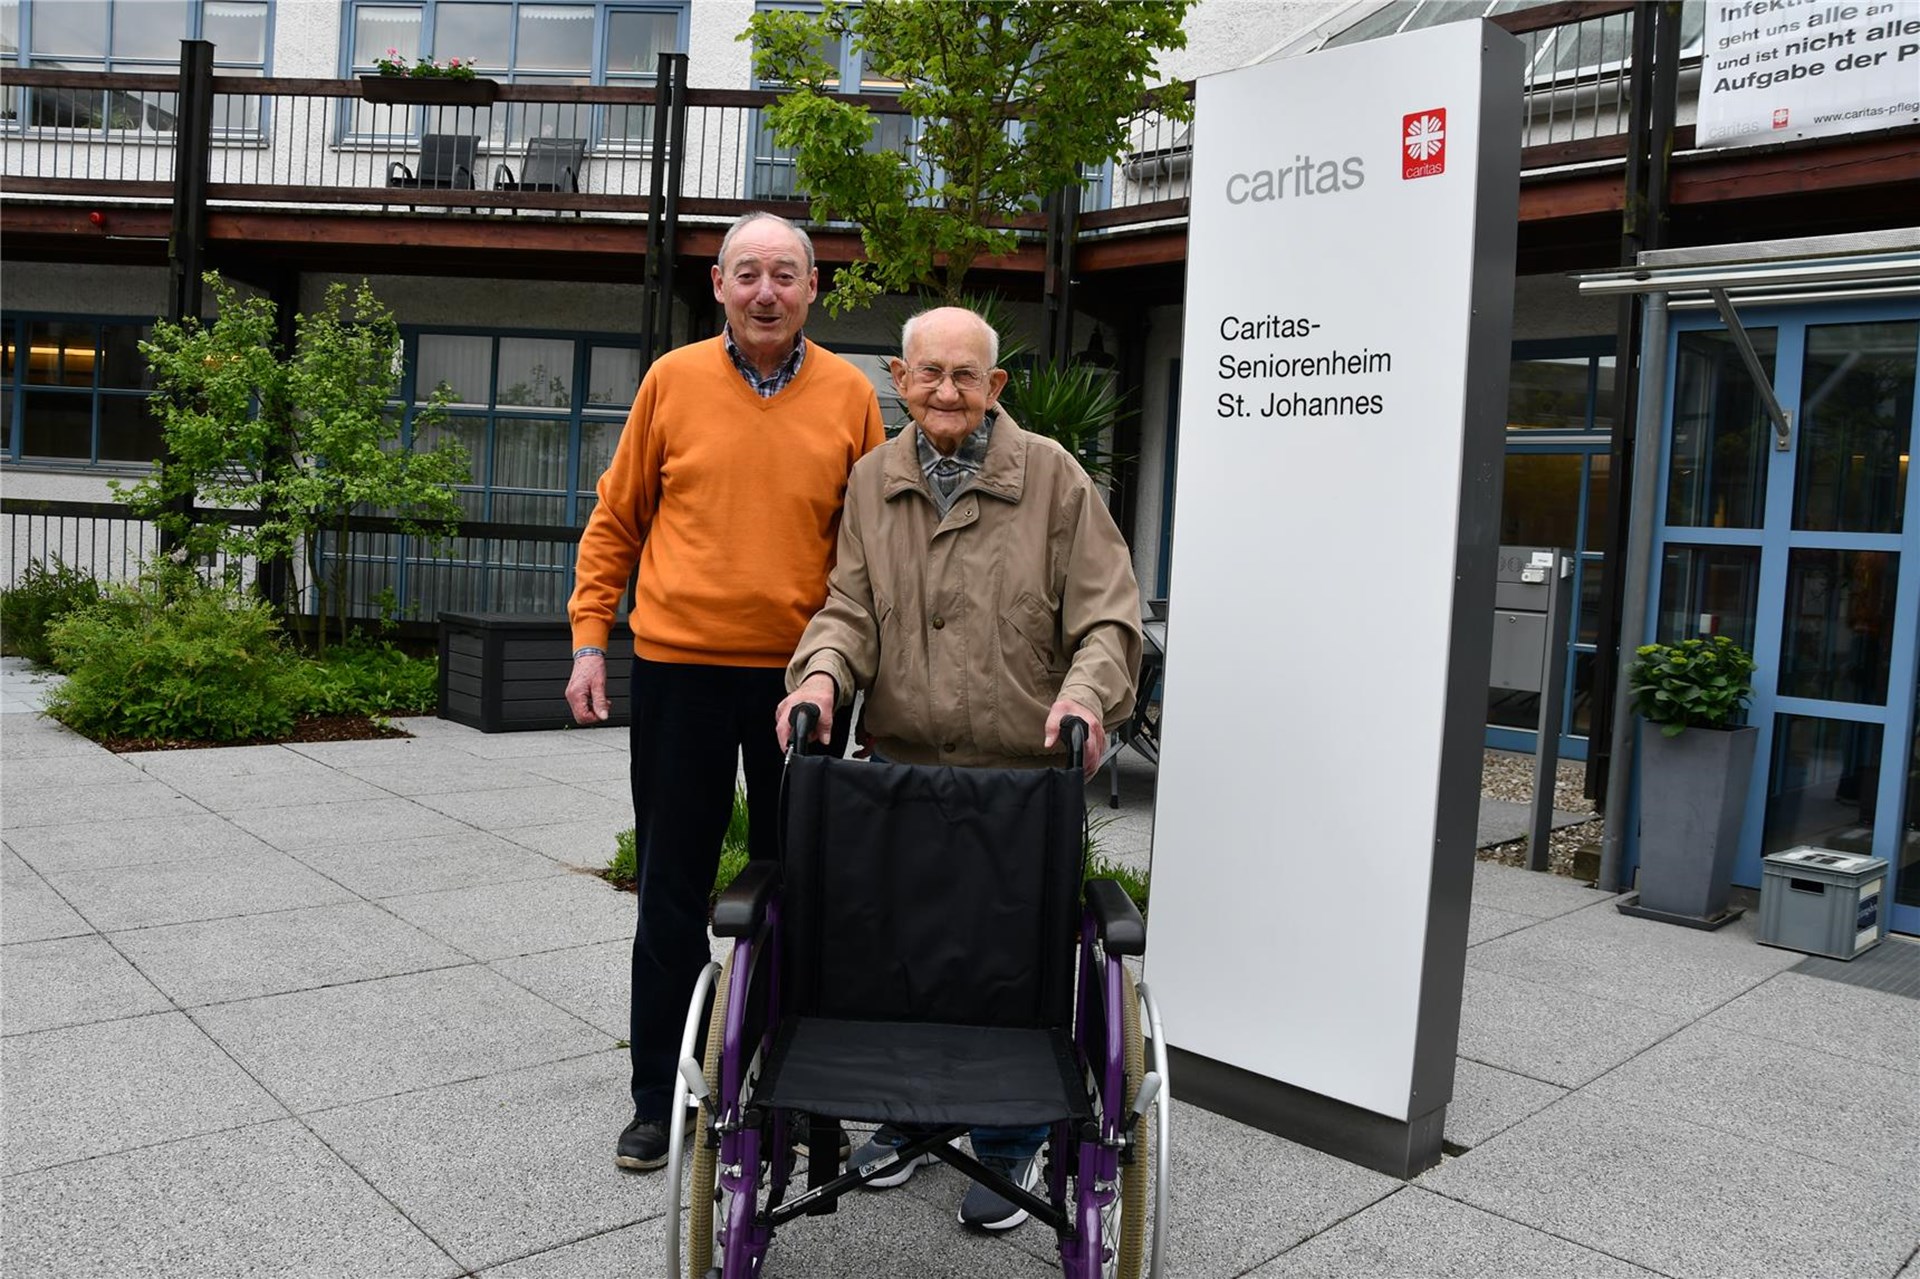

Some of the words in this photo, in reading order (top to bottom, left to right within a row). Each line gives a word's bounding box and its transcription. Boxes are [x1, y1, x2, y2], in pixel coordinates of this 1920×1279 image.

[1718, 28, 1760, 49] geht
[1766, 21, 1801, 37] uns
[1807, 6, 1859, 28] alle
[1865, 3, 1893, 17] an
[1720, 0, 1817, 23] Infek
[1717, 53, 1751, 70] und
[1755, 47, 1779, 63] ist
[1785, 28, 1857, 57] nicht
[1865, 19, 1920, 42] alle
[1713, 62, 1825, 94] Aufgabe
[1834, 53, 1888, 72] der
[1707, 121, 1760, 139] caritas
[1225, 154, 1366, 206] caritas
[1405, 163, 1443, 179] caritas
[1219, 314, 1322, 342] Caritas-
[1217, 347, 1393, 380] Seniorenheim
[1216, 392, 1252, 419] St.
[1260, 391, 1384, 418] Johannes
